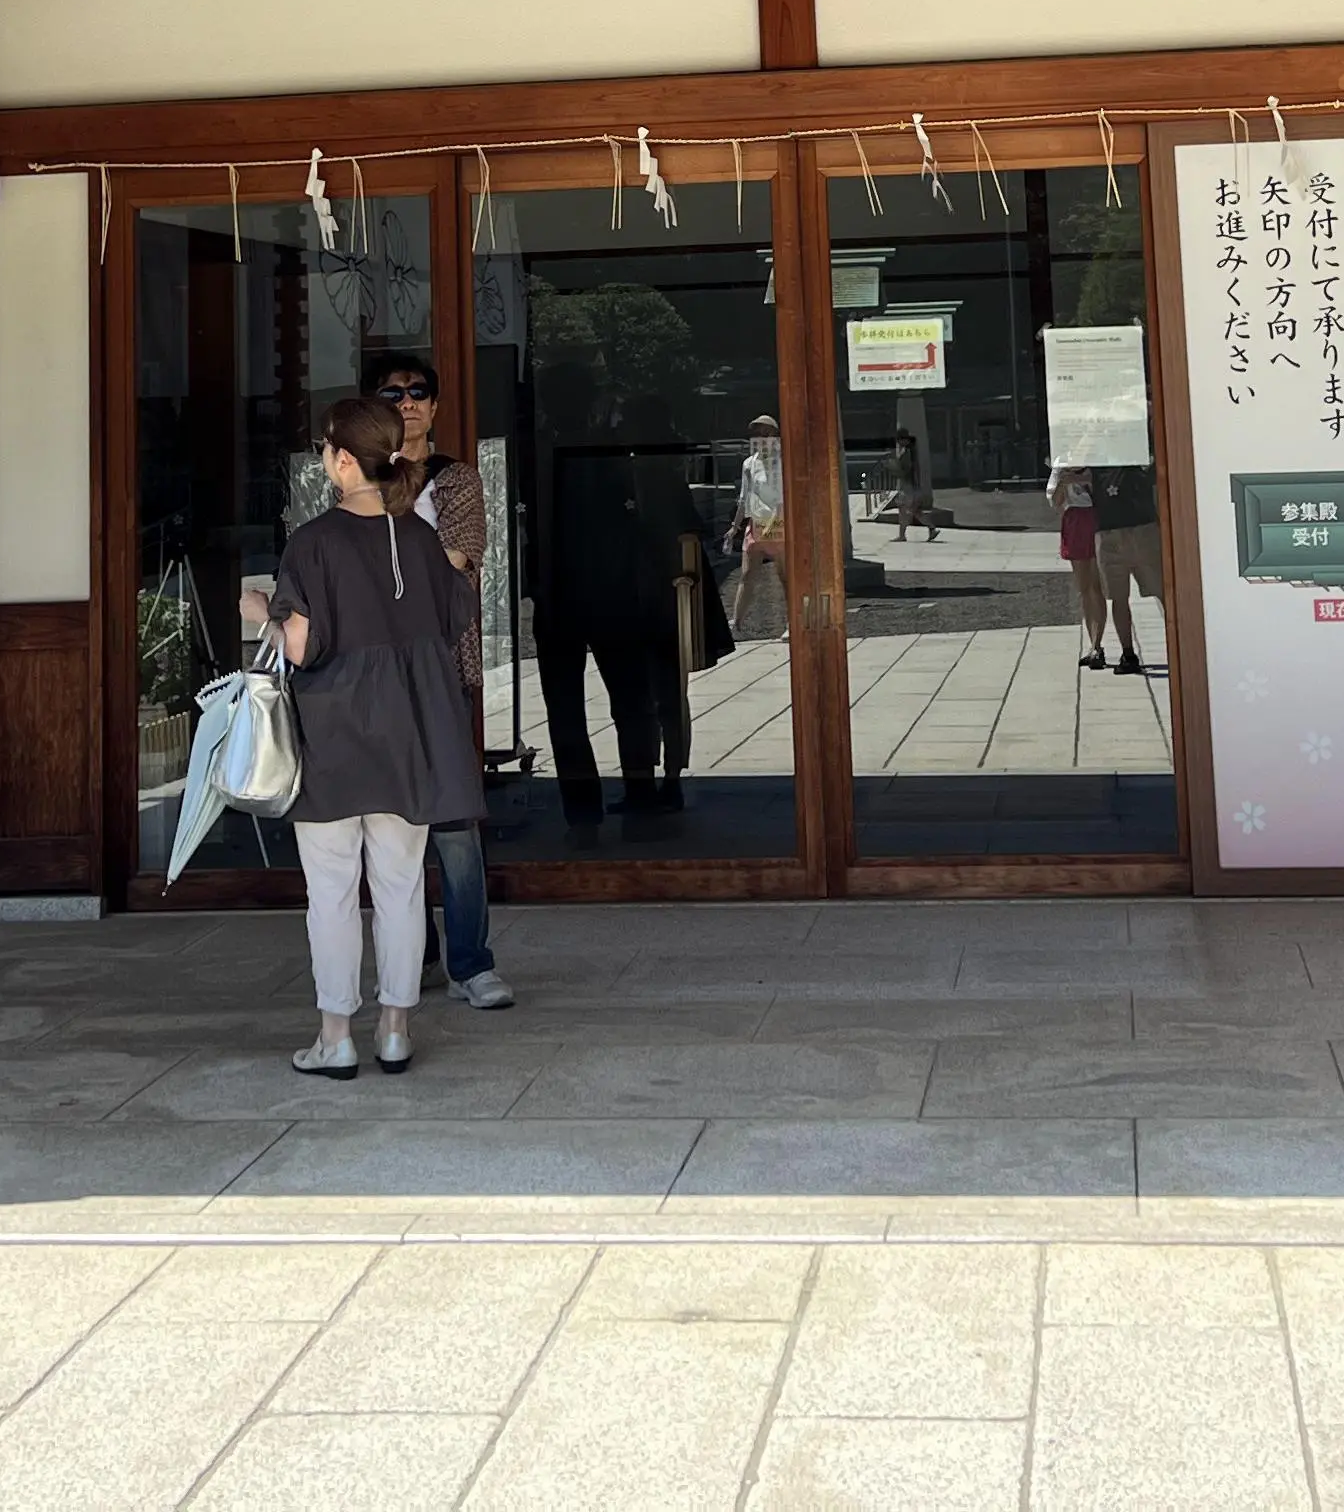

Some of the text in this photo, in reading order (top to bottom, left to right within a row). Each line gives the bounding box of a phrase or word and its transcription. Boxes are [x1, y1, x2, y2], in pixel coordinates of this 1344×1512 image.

[1214, 177, 1256, 405] お進みください
[1258, 175, 1301, 369] 矢印の方向へ
[1280, 501, 1339, 522] 参集殿
[1291, 527, 1330, 547] 受付
